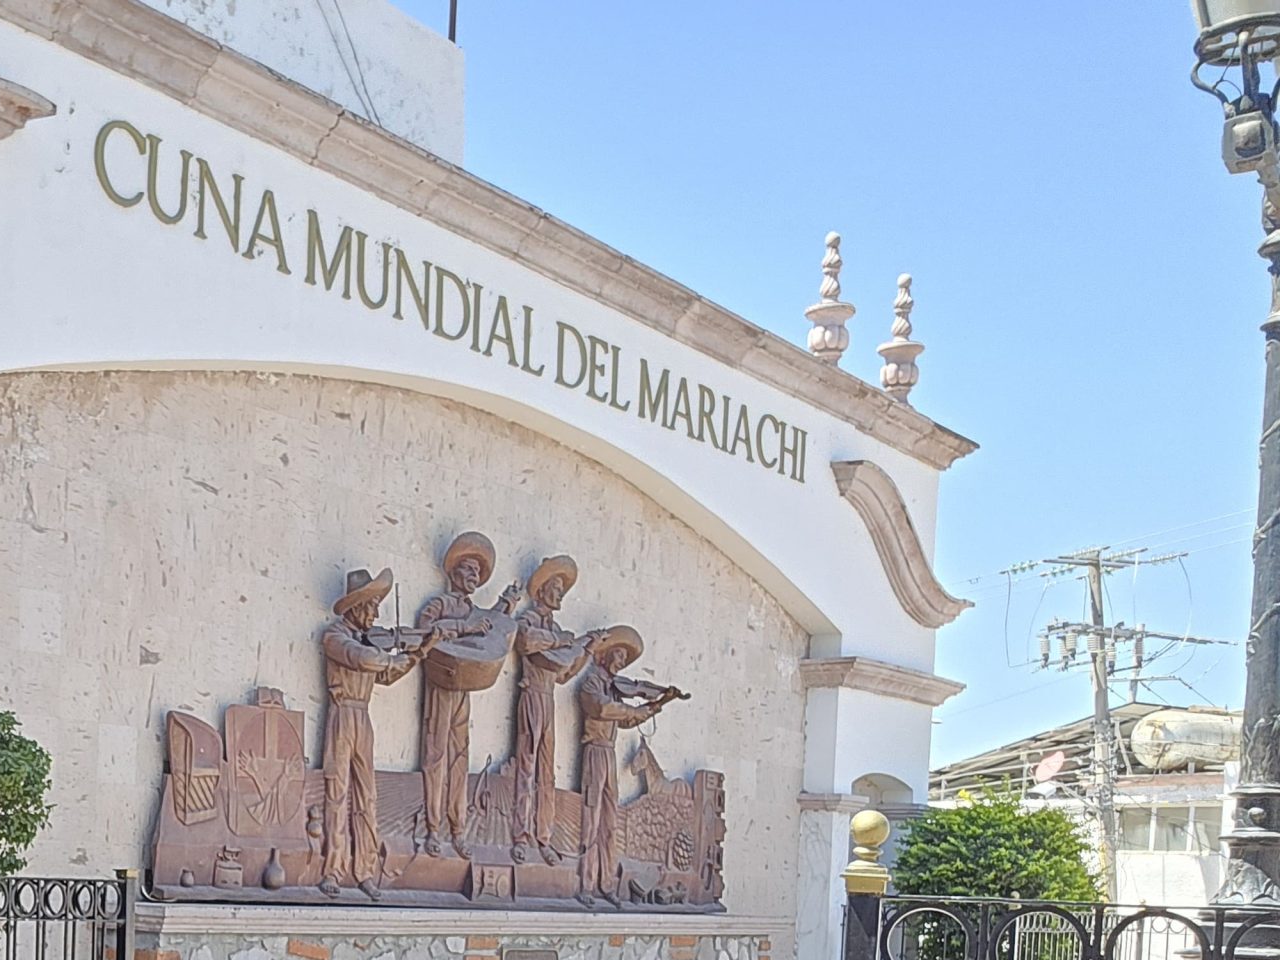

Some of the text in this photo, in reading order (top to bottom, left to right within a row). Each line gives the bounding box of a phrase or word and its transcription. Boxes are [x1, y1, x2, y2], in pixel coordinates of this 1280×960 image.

[93, 119, 809, 483] CUNA MUNDIAL DEL MARIACHI
